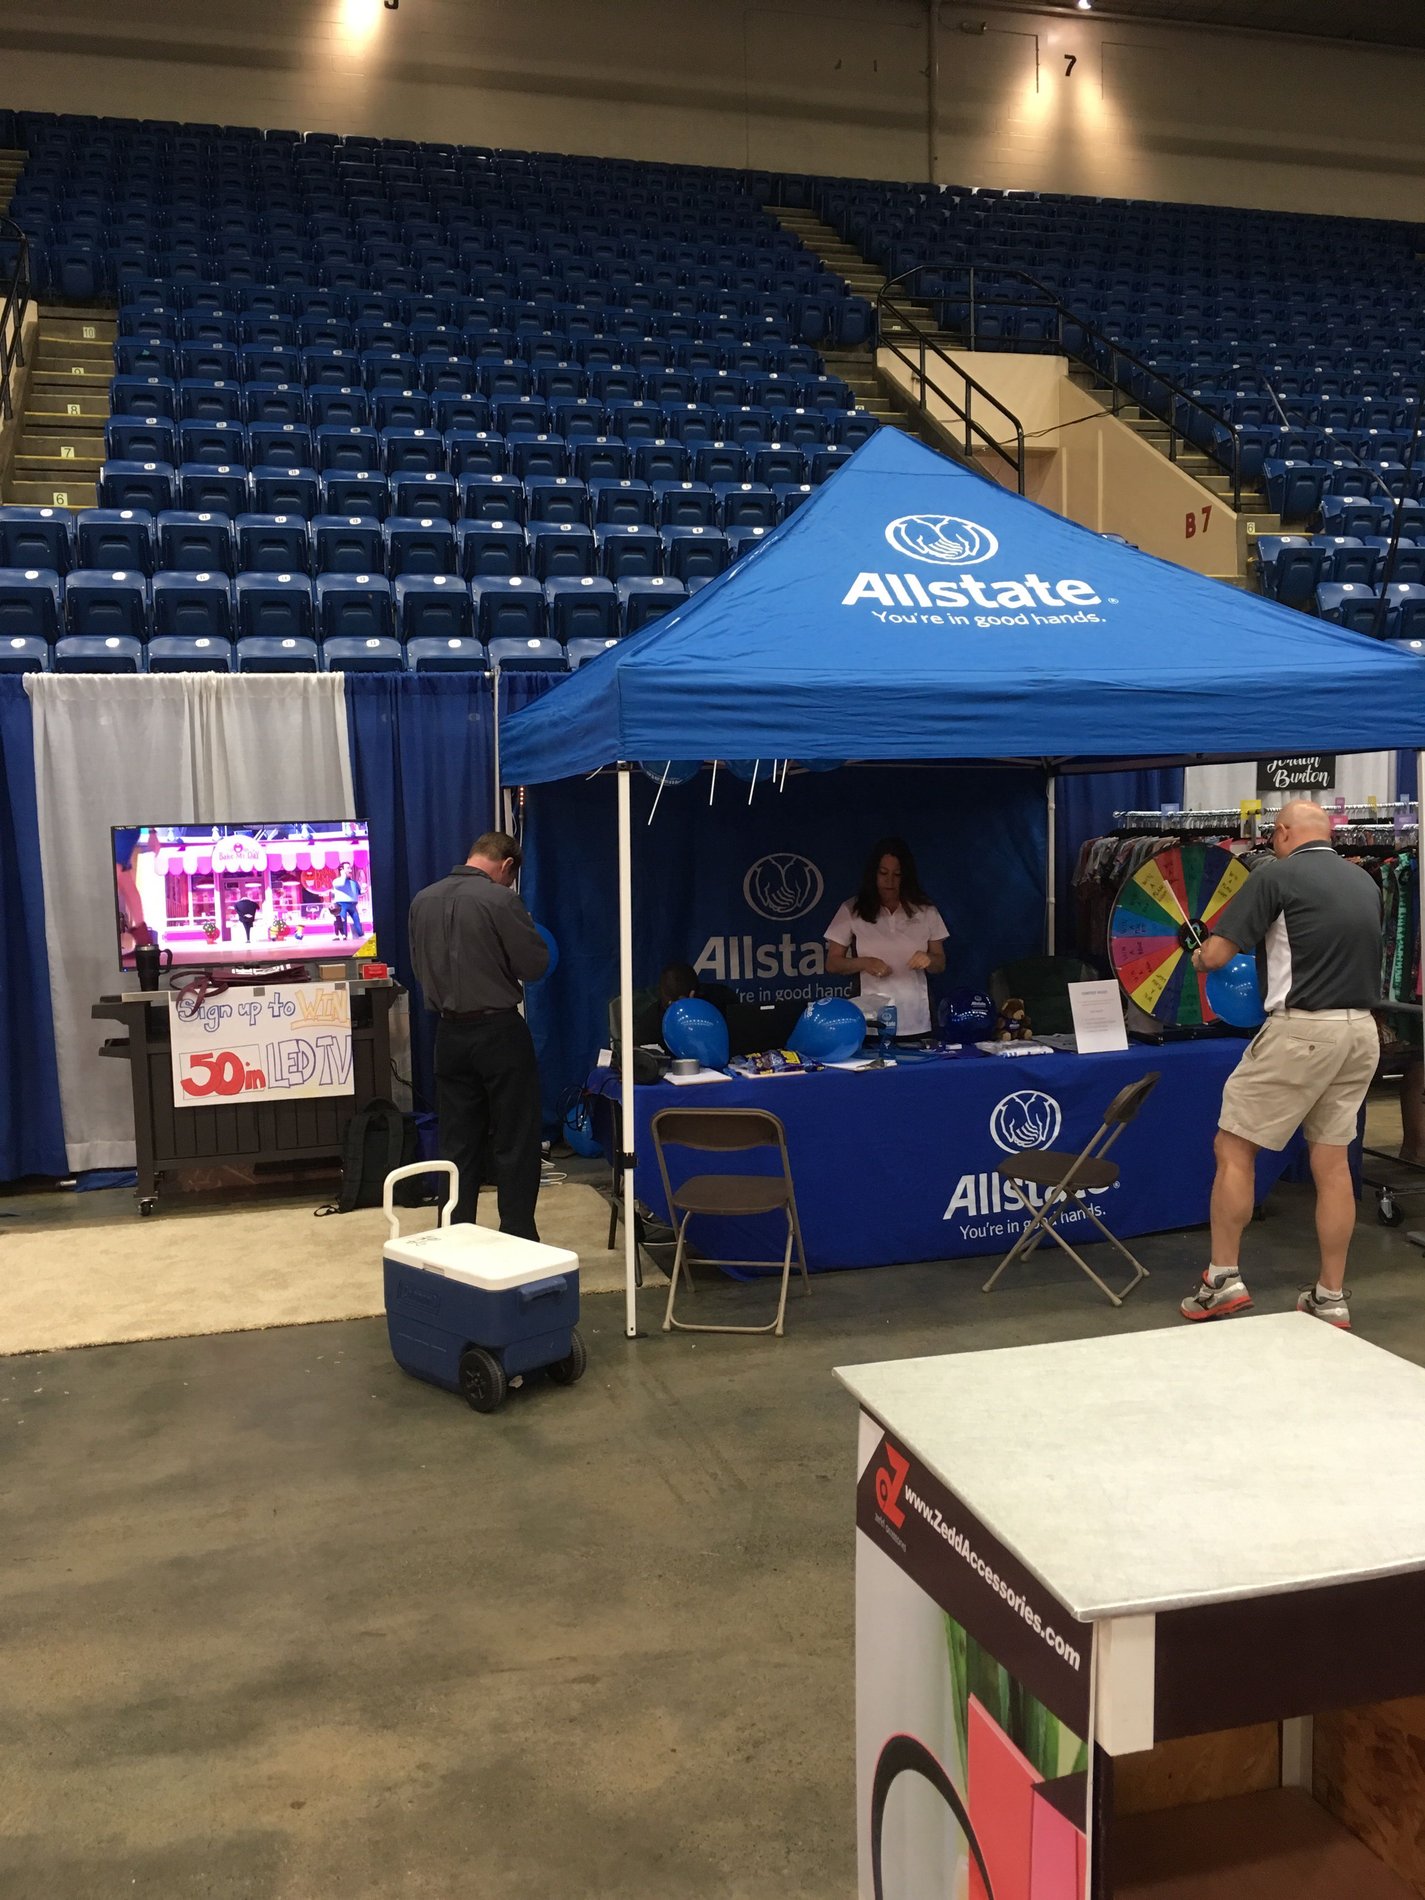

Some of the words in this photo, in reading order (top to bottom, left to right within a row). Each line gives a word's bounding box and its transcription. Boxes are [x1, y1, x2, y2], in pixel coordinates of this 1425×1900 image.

[1064, 54, 1077, 77] 7
[64, 447, 72, 458] 7
[56, 493, 65, 505] 6
[1185, 512, 1197, 539] B
[1201, 505, 1213, 533] 7
[841, 571, 1102, 609] Allstate
[872, 610, 945, 625] You're
[948, 612, 970, 625] in
[974, 611, 1030, 628] good
[1031, 610, 1106, 626] hands.
[1273, 764, 1331, 788] Burton
[693, 933, 826, 981] Allsta
[178, 998, 233, 1033] Sign
[237, 1000, 263, 1027] up
[267, 991, 297, 1019] to
[295, 987, 349, 1024] WIN
[759, 987, 772, 1002] in
[775, 983, 812, 1001] good
[266, 1038, 316, 1089] LED
[316, 1034, 353, 1087] TV
[942, 1171, 1109, 1221] Allsta
[959, 1220, 1004, 1240] You're
[1007, 1219, 1020, 1234] in
[1060, 1202, 1106, 1225] hands.
[904, 1484, 1081, 1672] www.ZeddAccessories.com
